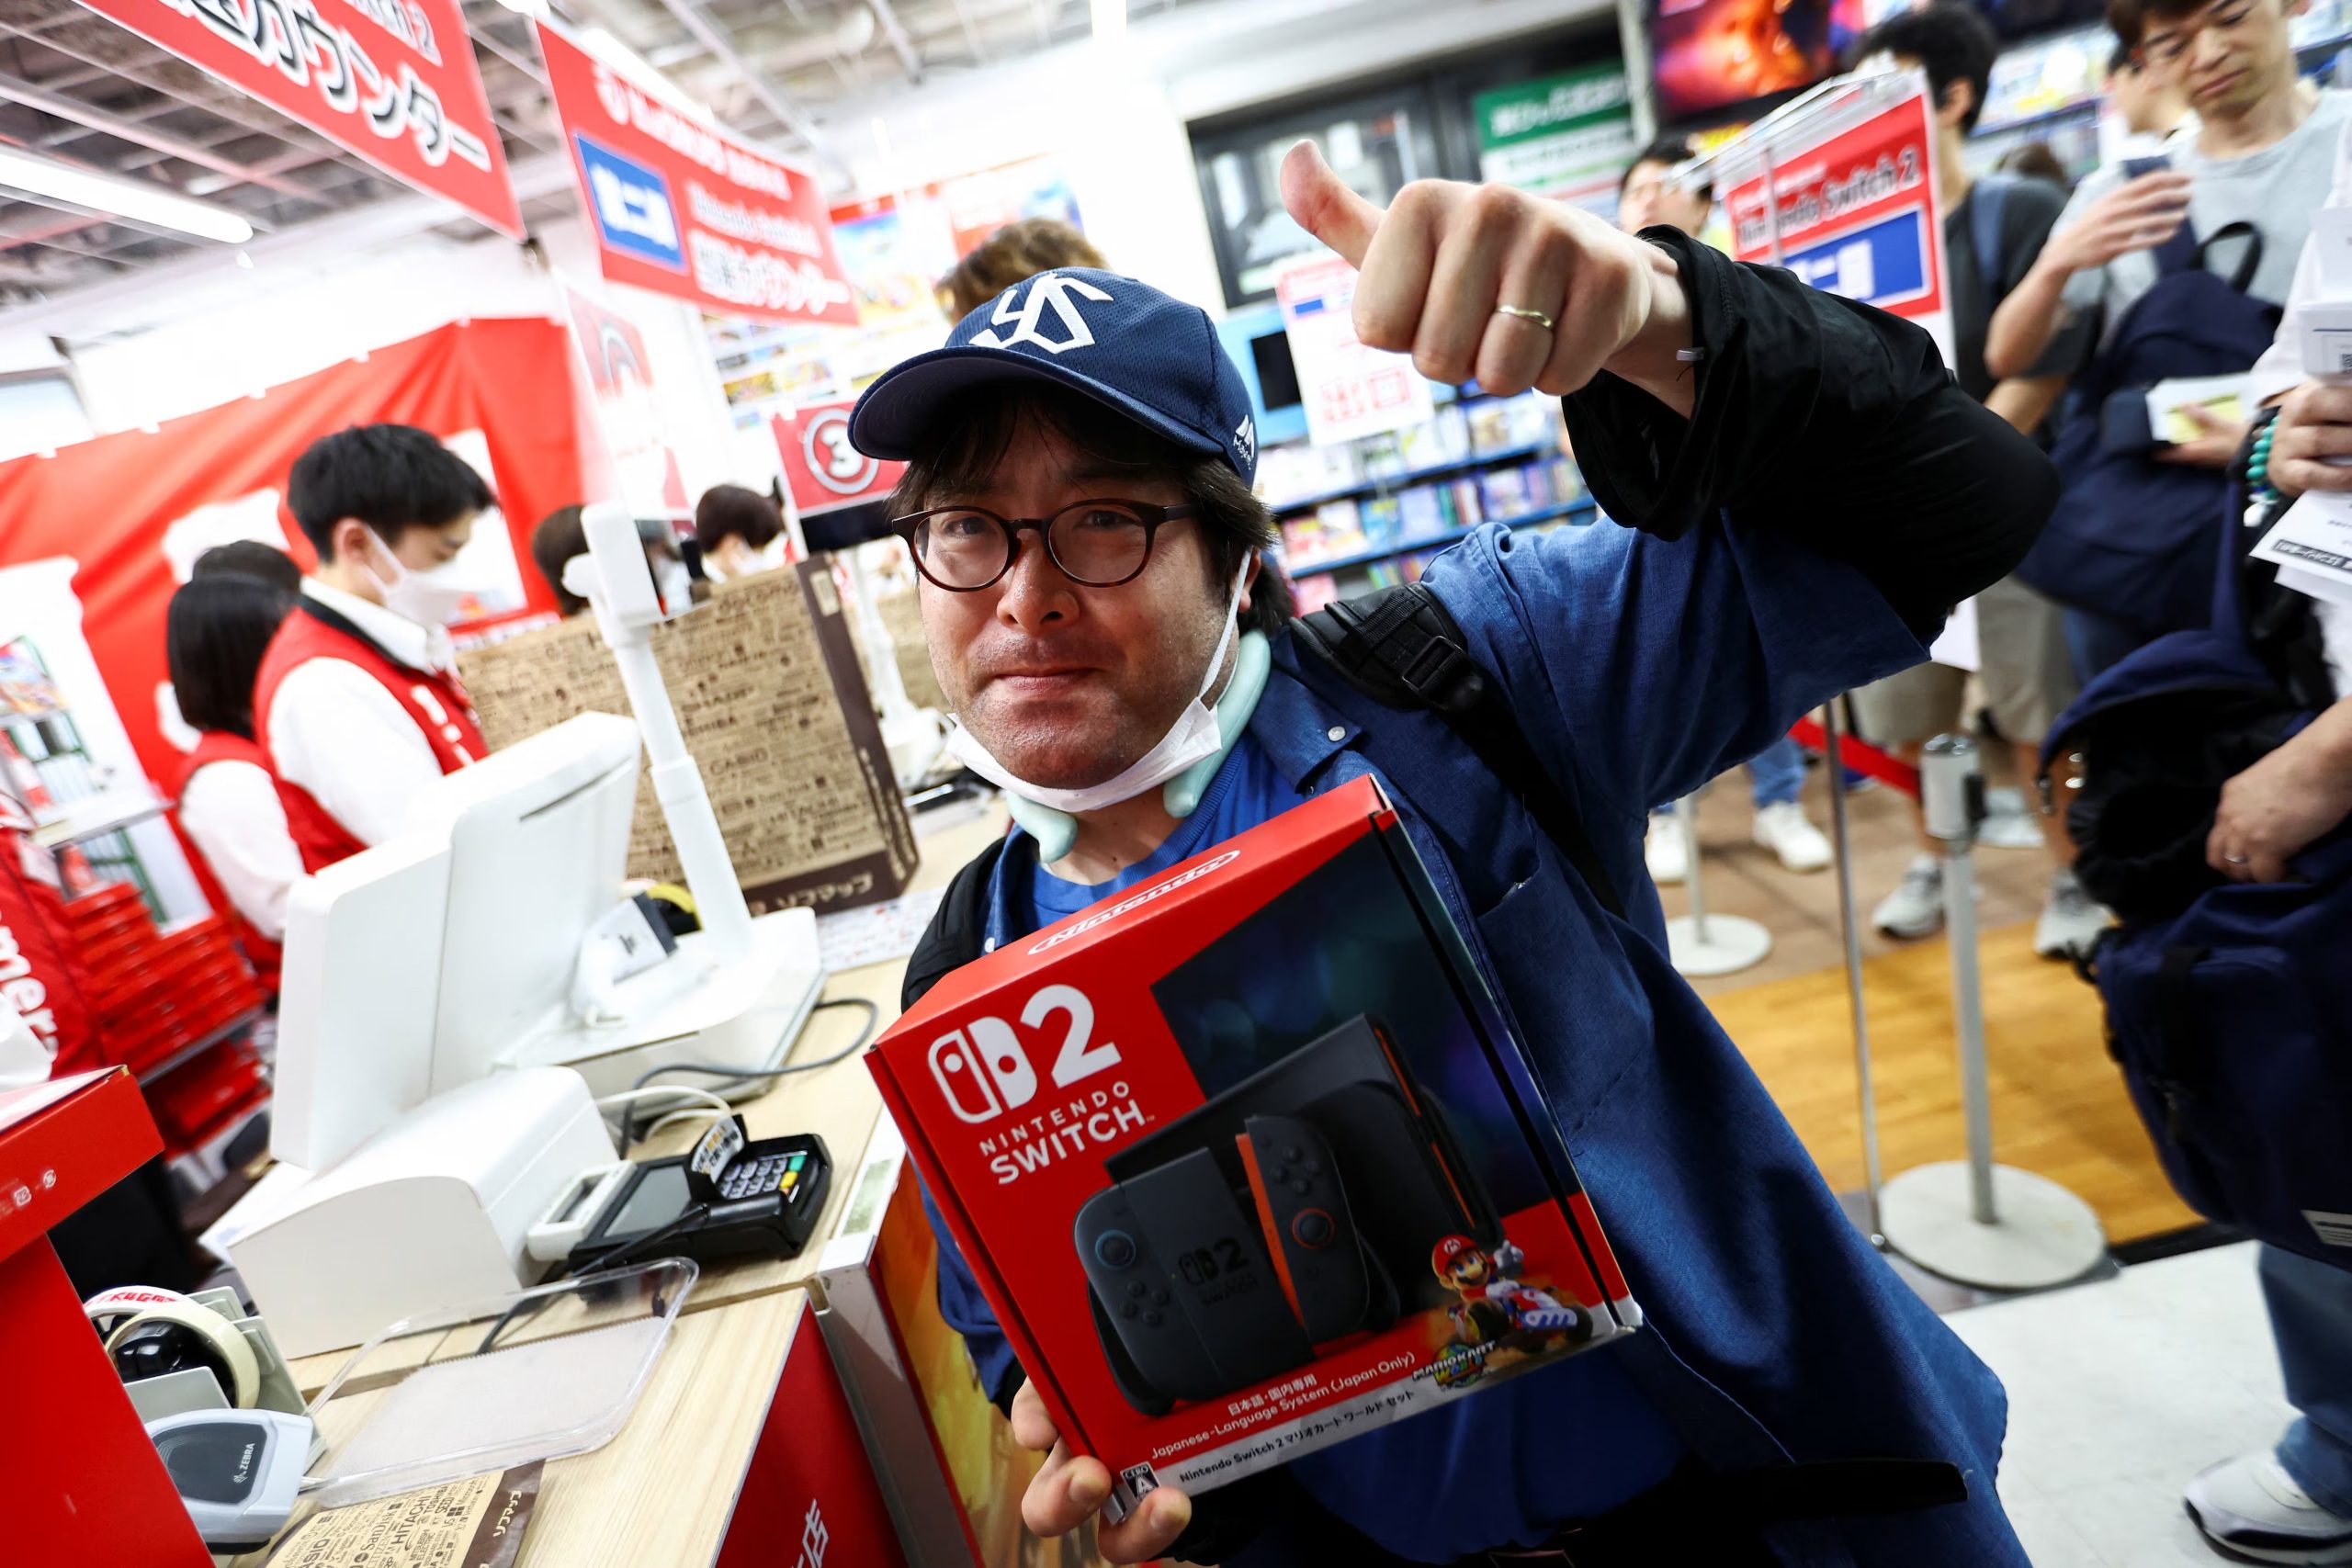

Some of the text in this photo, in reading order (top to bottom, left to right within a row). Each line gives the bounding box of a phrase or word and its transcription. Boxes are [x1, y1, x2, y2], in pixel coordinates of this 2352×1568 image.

[1899, 145, 1927, 186] 2
[820, 425, 864, 479] 3
[1046, 858, 1224, 947] Nintendo
[1020, 984, 1122, 1089] 2
[979, 1081, 1130, 1156] NINTENDO
[990, 1099, 1146, 1185] SWITCH
[1151, 1351, 1417, 1460] Japanese-Language System (Japan Only)
[239, 1442, 256, 1471] ZEBRA
[1180, 1388, 1416, 1483] Nintendo Switch 2 マリオカート ワールド セット
[360, 1510, 397, 1551] SanDisk
[390, 1495, 432, 1544] HITACHI
[492, 1490, 523, 1538] ソフマップ
[298, 1539, 331, 1568] ASIO
